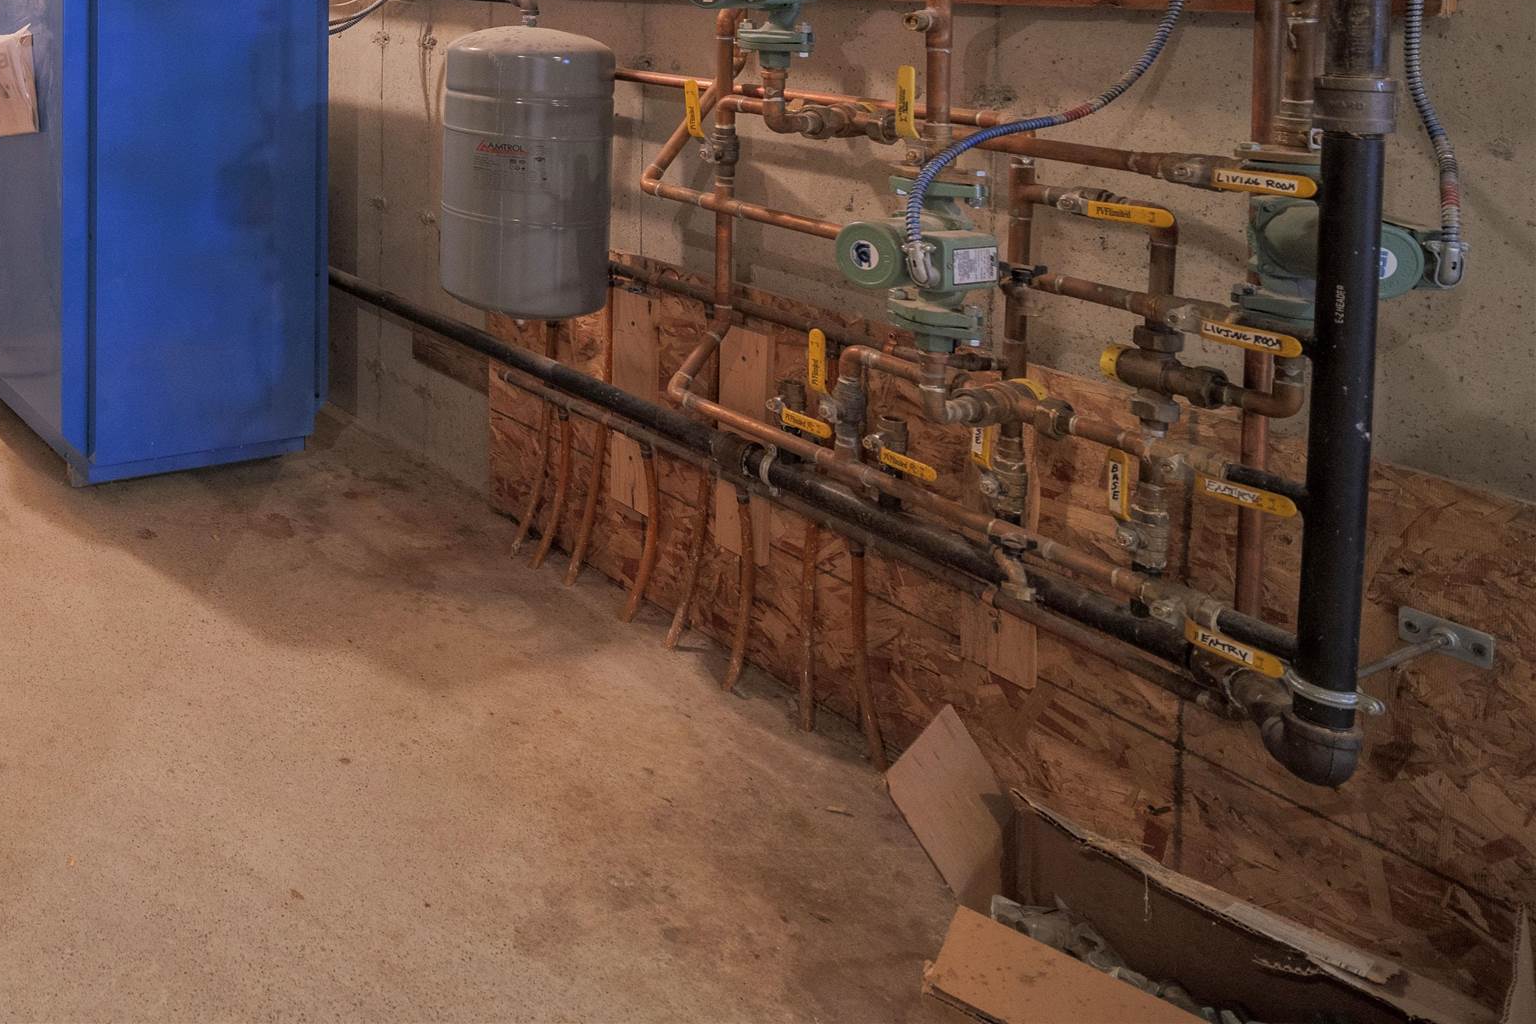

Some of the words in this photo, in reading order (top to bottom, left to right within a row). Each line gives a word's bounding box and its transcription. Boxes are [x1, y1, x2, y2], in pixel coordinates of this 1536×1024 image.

[487, 142, 523, 152] AMTROL
[1265, 179, 1296, 191] ROOM
[1336, 285, 1345, 311] HEADER
[1111, 463, 1120, 500] BASE
[1202, 633, 1248, 661] ENTRY
